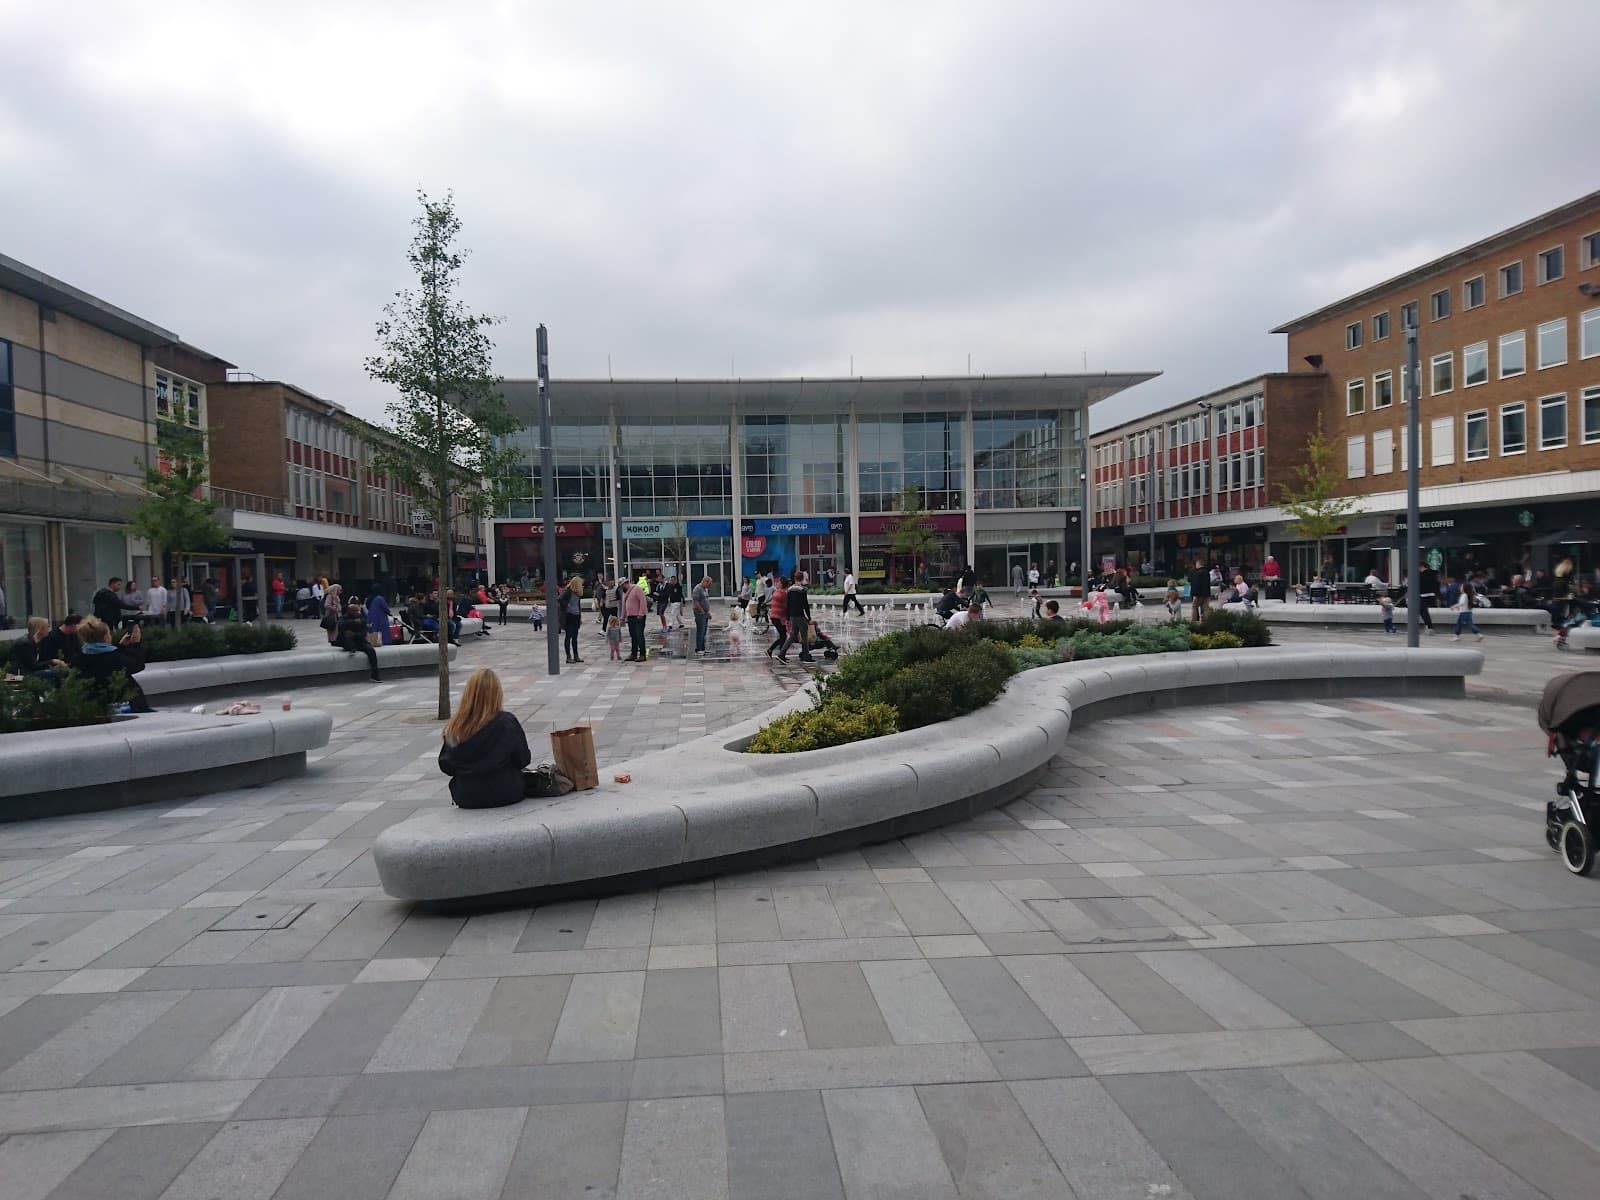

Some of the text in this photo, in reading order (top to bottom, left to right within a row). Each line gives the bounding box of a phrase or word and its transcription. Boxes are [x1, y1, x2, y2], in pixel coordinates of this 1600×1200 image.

[626, 525, 660, 533] KOKORO
[741, 524, 754, 532] gym
[770, 522, 808, 532] gymgroup
[830, 522, 843, 531] gym
[1395, 519, 1455, 530] STACKS COFFEE
[530, 525, 567, 534] COTA
